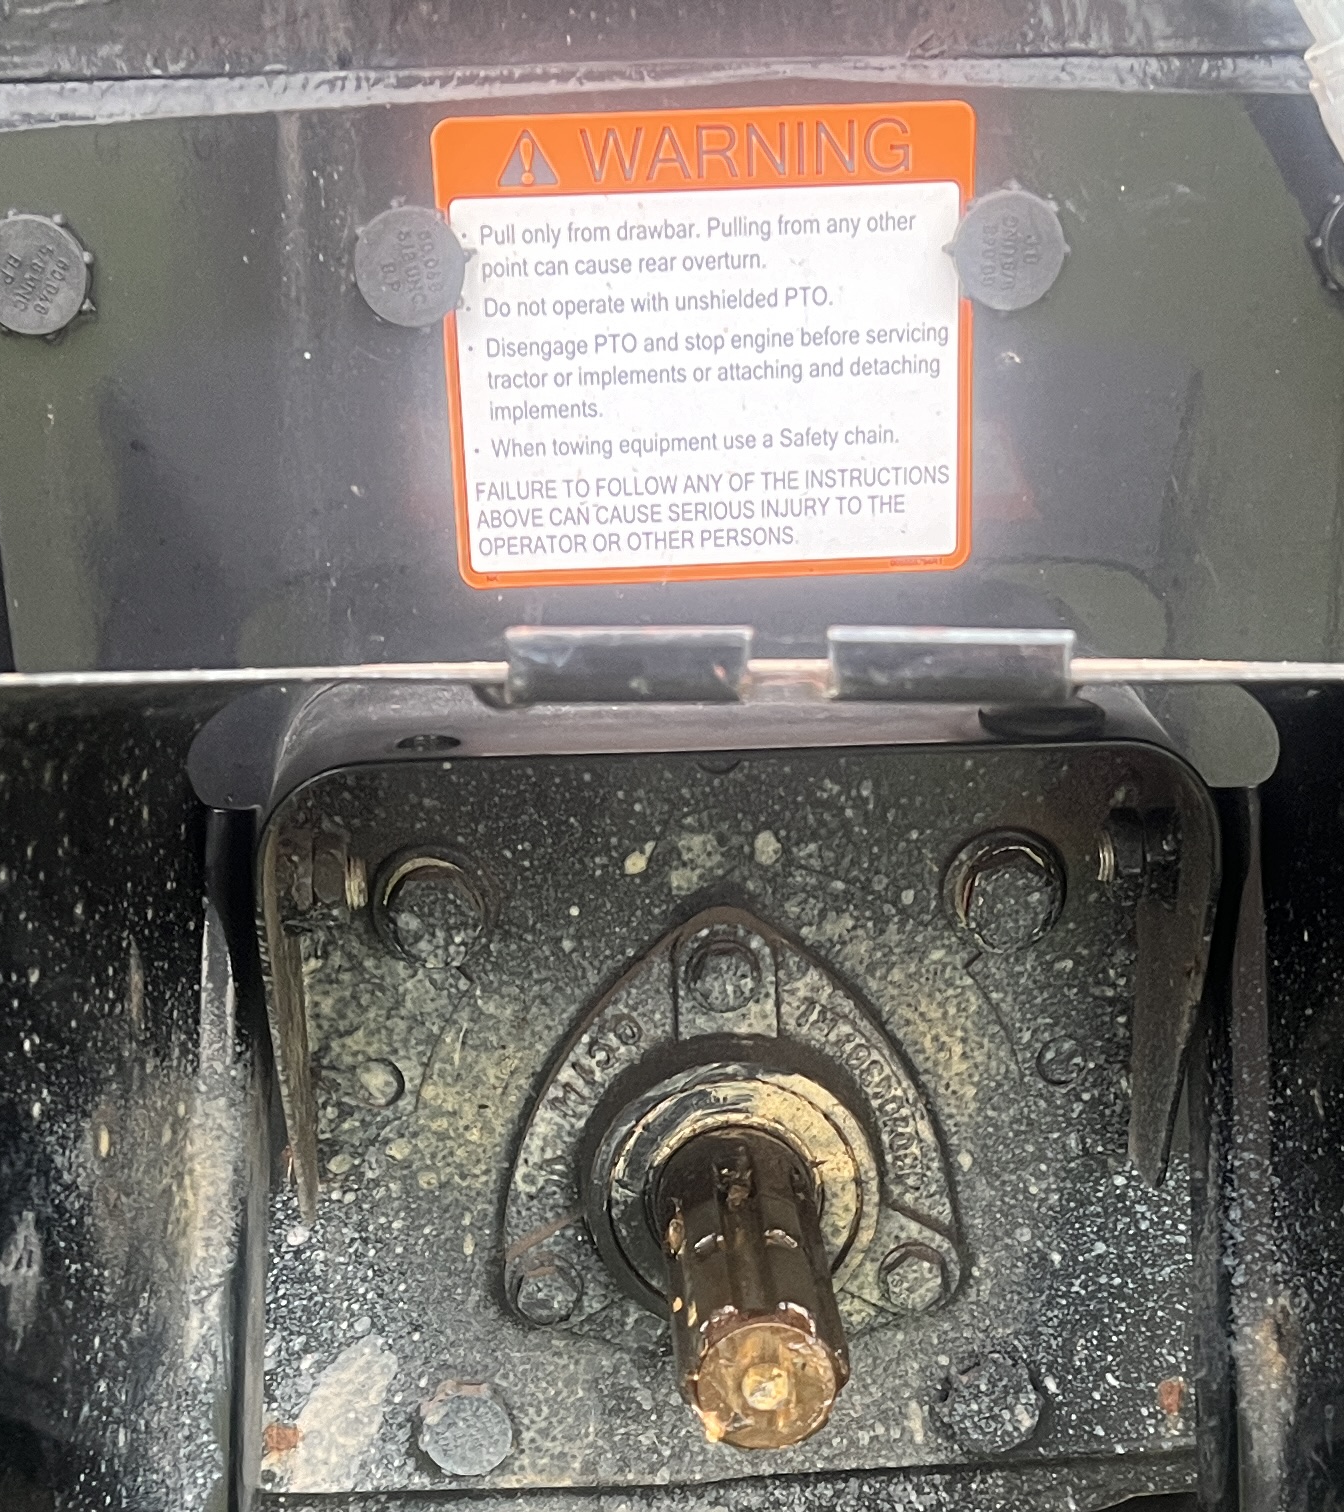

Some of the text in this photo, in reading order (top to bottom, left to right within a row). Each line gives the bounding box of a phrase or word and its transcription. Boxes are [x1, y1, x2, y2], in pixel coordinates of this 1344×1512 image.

[579, 116, 912, 183] WARNING
[480, 211, 916, 248] Pull only from drawbar. Pulling from any other
[481, 252, 766, 282] point can cause rear overturn.
[484, 286, 833, 319] Do not operate with unshielded PTO.
[487, 323, 948, 361] Disengage PTO and stop engine before servicing
[488, 354, 940, 389] tractor or implements or attaching and detaching
[490, 400, 603, 425] implements.
[491, 424, 899, 459] When towing equipment use a Safety chain.
[476, 465, 949, 501] FAILURE TO FOLLOW ANY OF THE INSTRUCTIONS
[477, 494, 905, 529] ABOVE CAN CAUSE SERIOUS INJURY TO THE
[479, 526, 798, 556] OPERATOR OR OTHER PERSONS.
